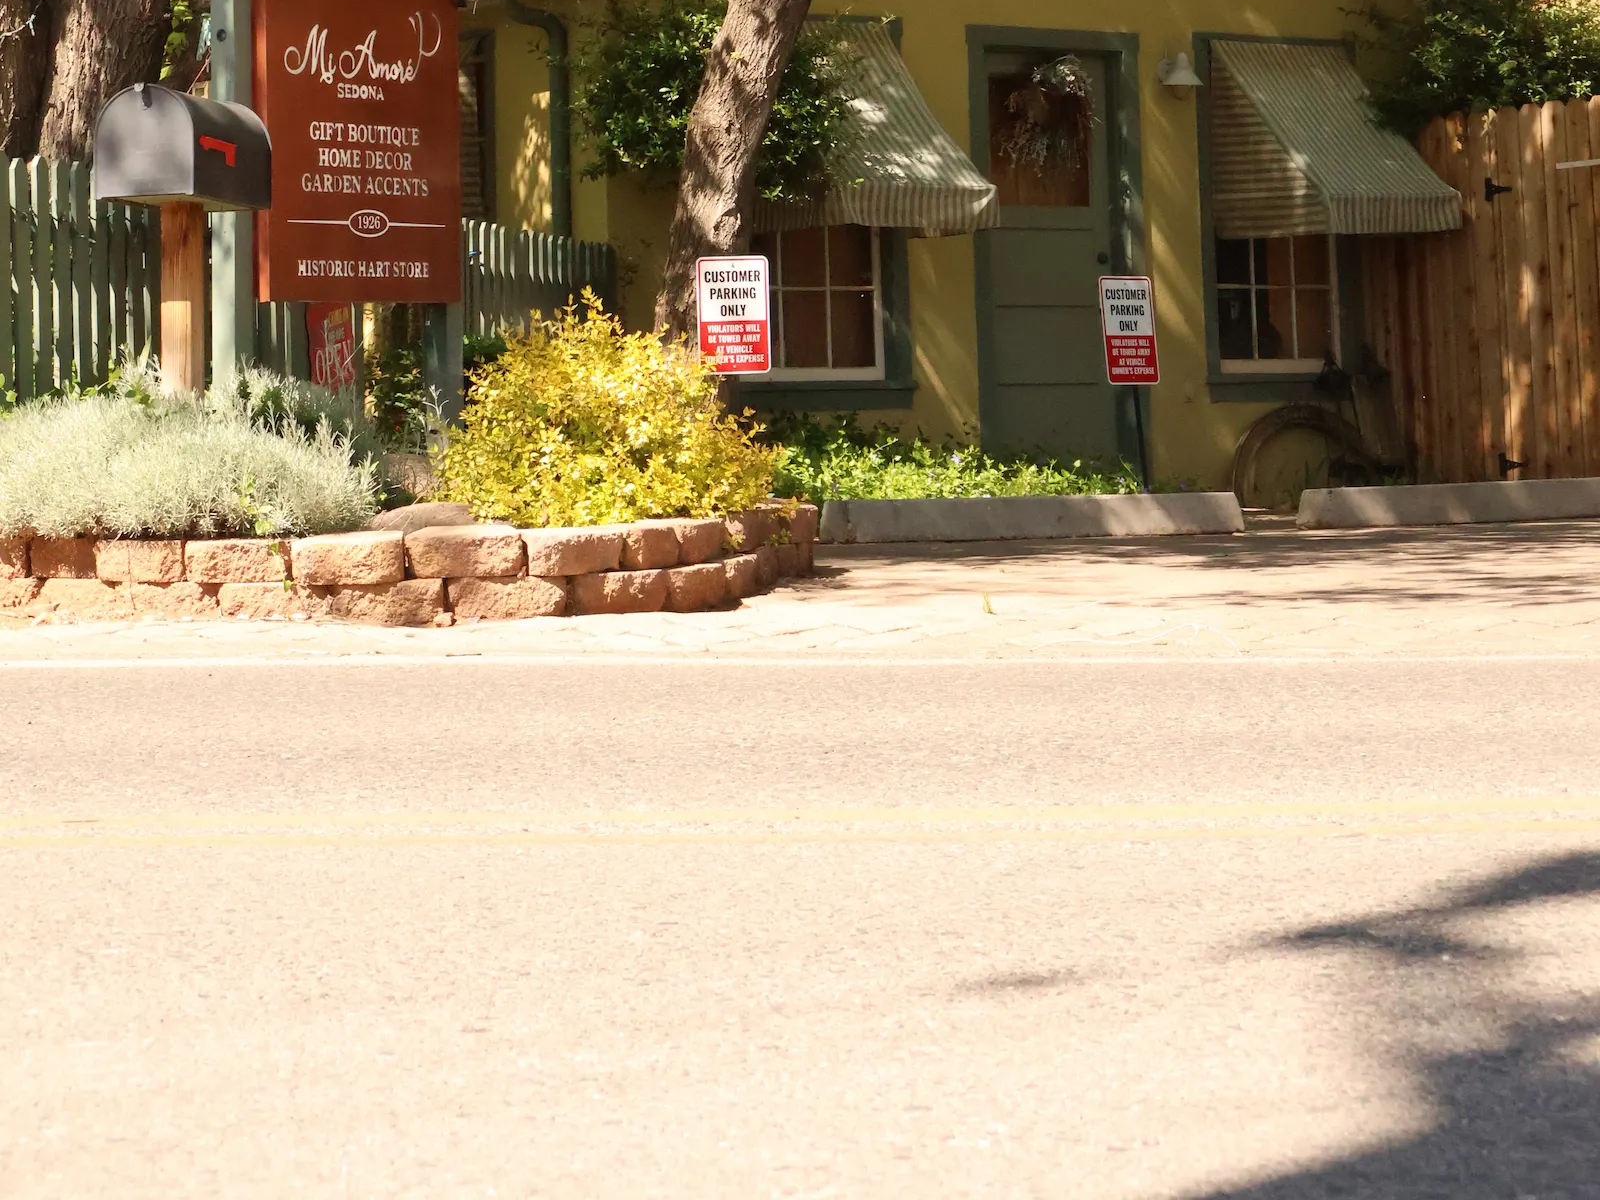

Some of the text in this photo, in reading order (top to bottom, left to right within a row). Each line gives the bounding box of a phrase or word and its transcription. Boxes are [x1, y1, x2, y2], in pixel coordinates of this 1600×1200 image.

[284, 24, 337, 84] Mi
[337, 83, 385, 101] SEDONA
[309, 121, 421, 147] GIFT BOUTIQUE
[318, 148, 413, 171] HOME DECOR
[301, 173, 429, 197] GARDEN ACCENTS
[357, 215, 381, 229] 1926
[297, 259, 430, 278] HISTORIC HART STORE
[704, 270, 761, 283] CUSTOMER
[709, 287, 757, 300] PARKING
[1105, 288, 1147, 300] CUSTOMER
[720, 304, 746, 317] ONLY
[1110, 304, 1145, 316] PARKING
[707, 323, 761, 333] VIOLATORS WILL
[1119, 320, 1138, 332] ONLY
[708, 334, 761, 344] BE TOWED AWAY
[716, 344, 753, 354] AT VEHICLE
[316, 340, 354, 384] OPEN
[736, 354, 765, 363] EXPENSE
[1134, 367, 1155, 375] EXPENSE
